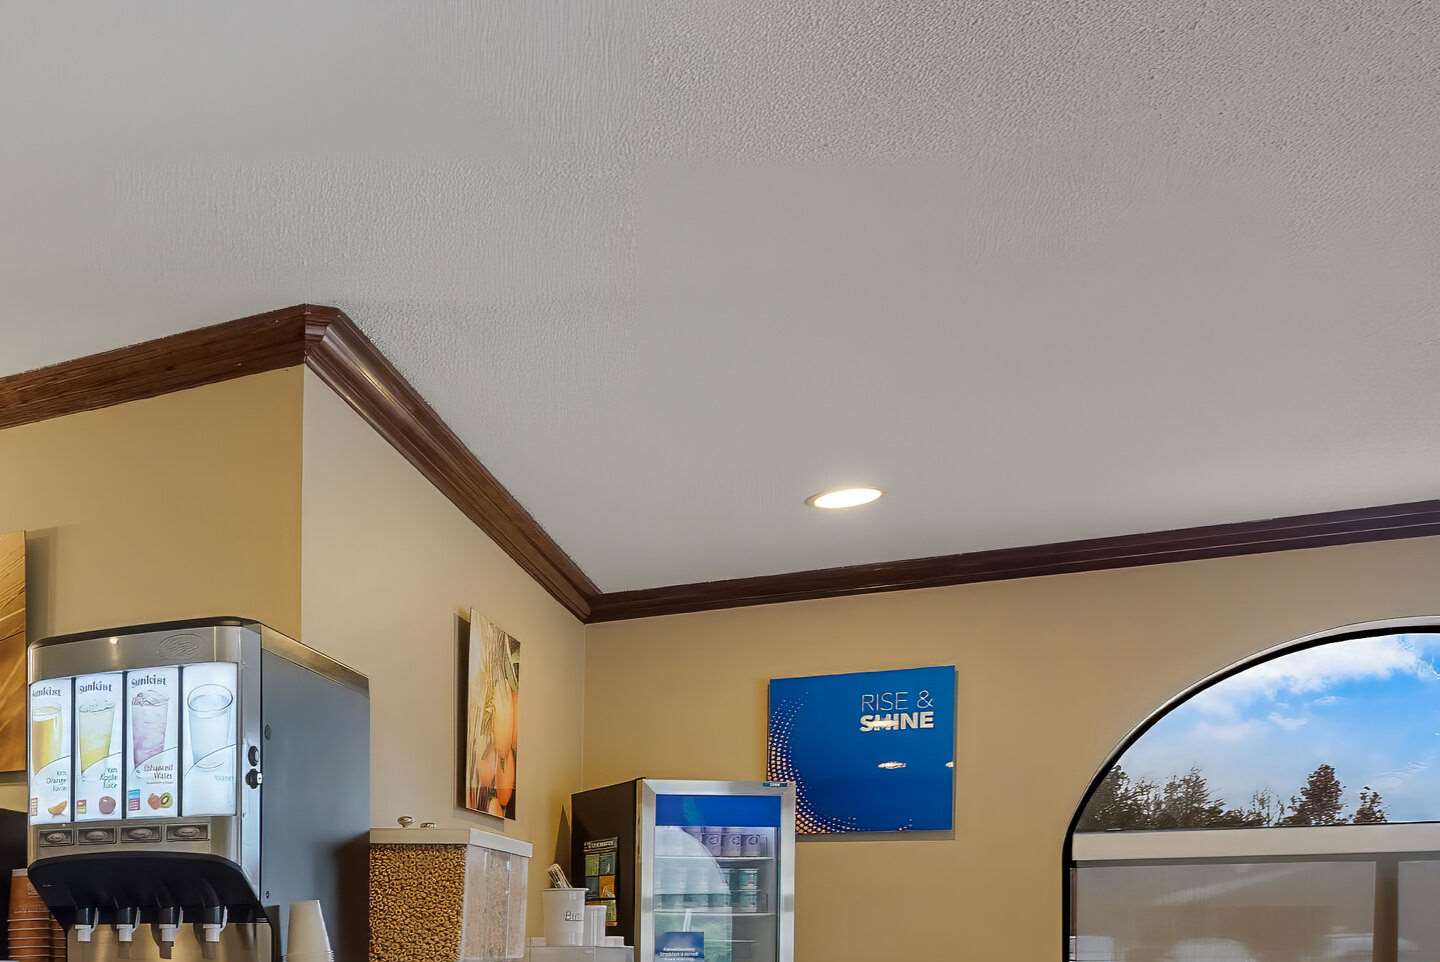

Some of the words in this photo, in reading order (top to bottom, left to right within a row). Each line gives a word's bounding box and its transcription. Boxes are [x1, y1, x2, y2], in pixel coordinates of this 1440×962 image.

[861, 691, 909, 713] RISE
[916, 689, 935, 709] &
[859, 711, 935, 732] SHINE
